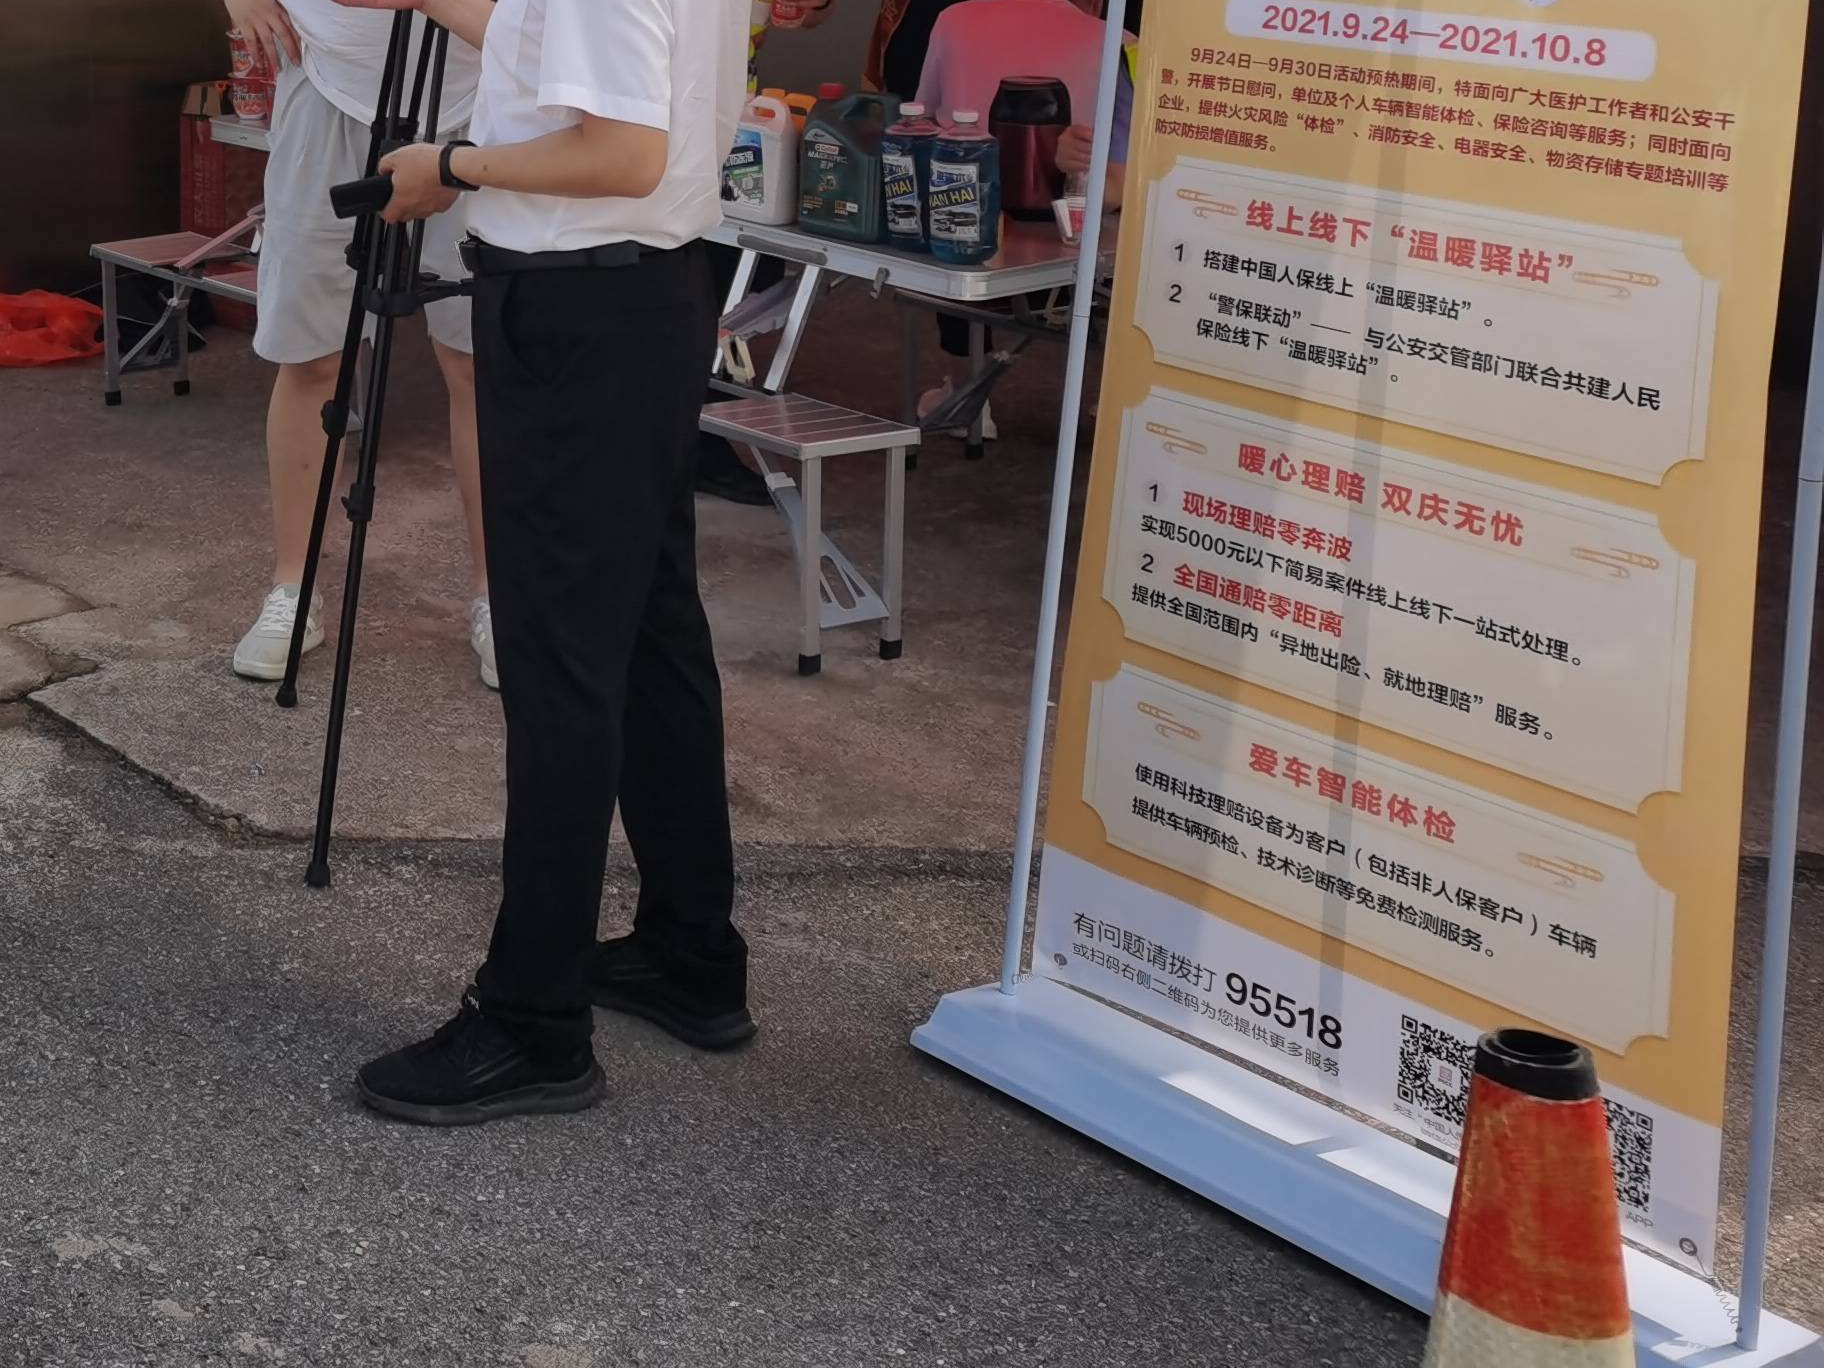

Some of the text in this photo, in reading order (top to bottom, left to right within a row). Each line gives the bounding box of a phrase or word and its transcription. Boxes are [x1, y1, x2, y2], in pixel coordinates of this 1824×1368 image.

[1168, 284, 1182, 303] 2
[1182, 490, 1354, 563] 现场理赔零奔波
[1238, 443, 1524, 548] 暖心理赔 双庆无忧
[1140, 553, 1345, 639] 2 全国通赔零距离
[1248, 742, 1457, 844] 爱车智能体检
[1071, 942, 1341, 1078] 或扫码右侧二维码为您提供更多服务
[1072, 912, 1344, 1051] 有问题请拨打 95518
